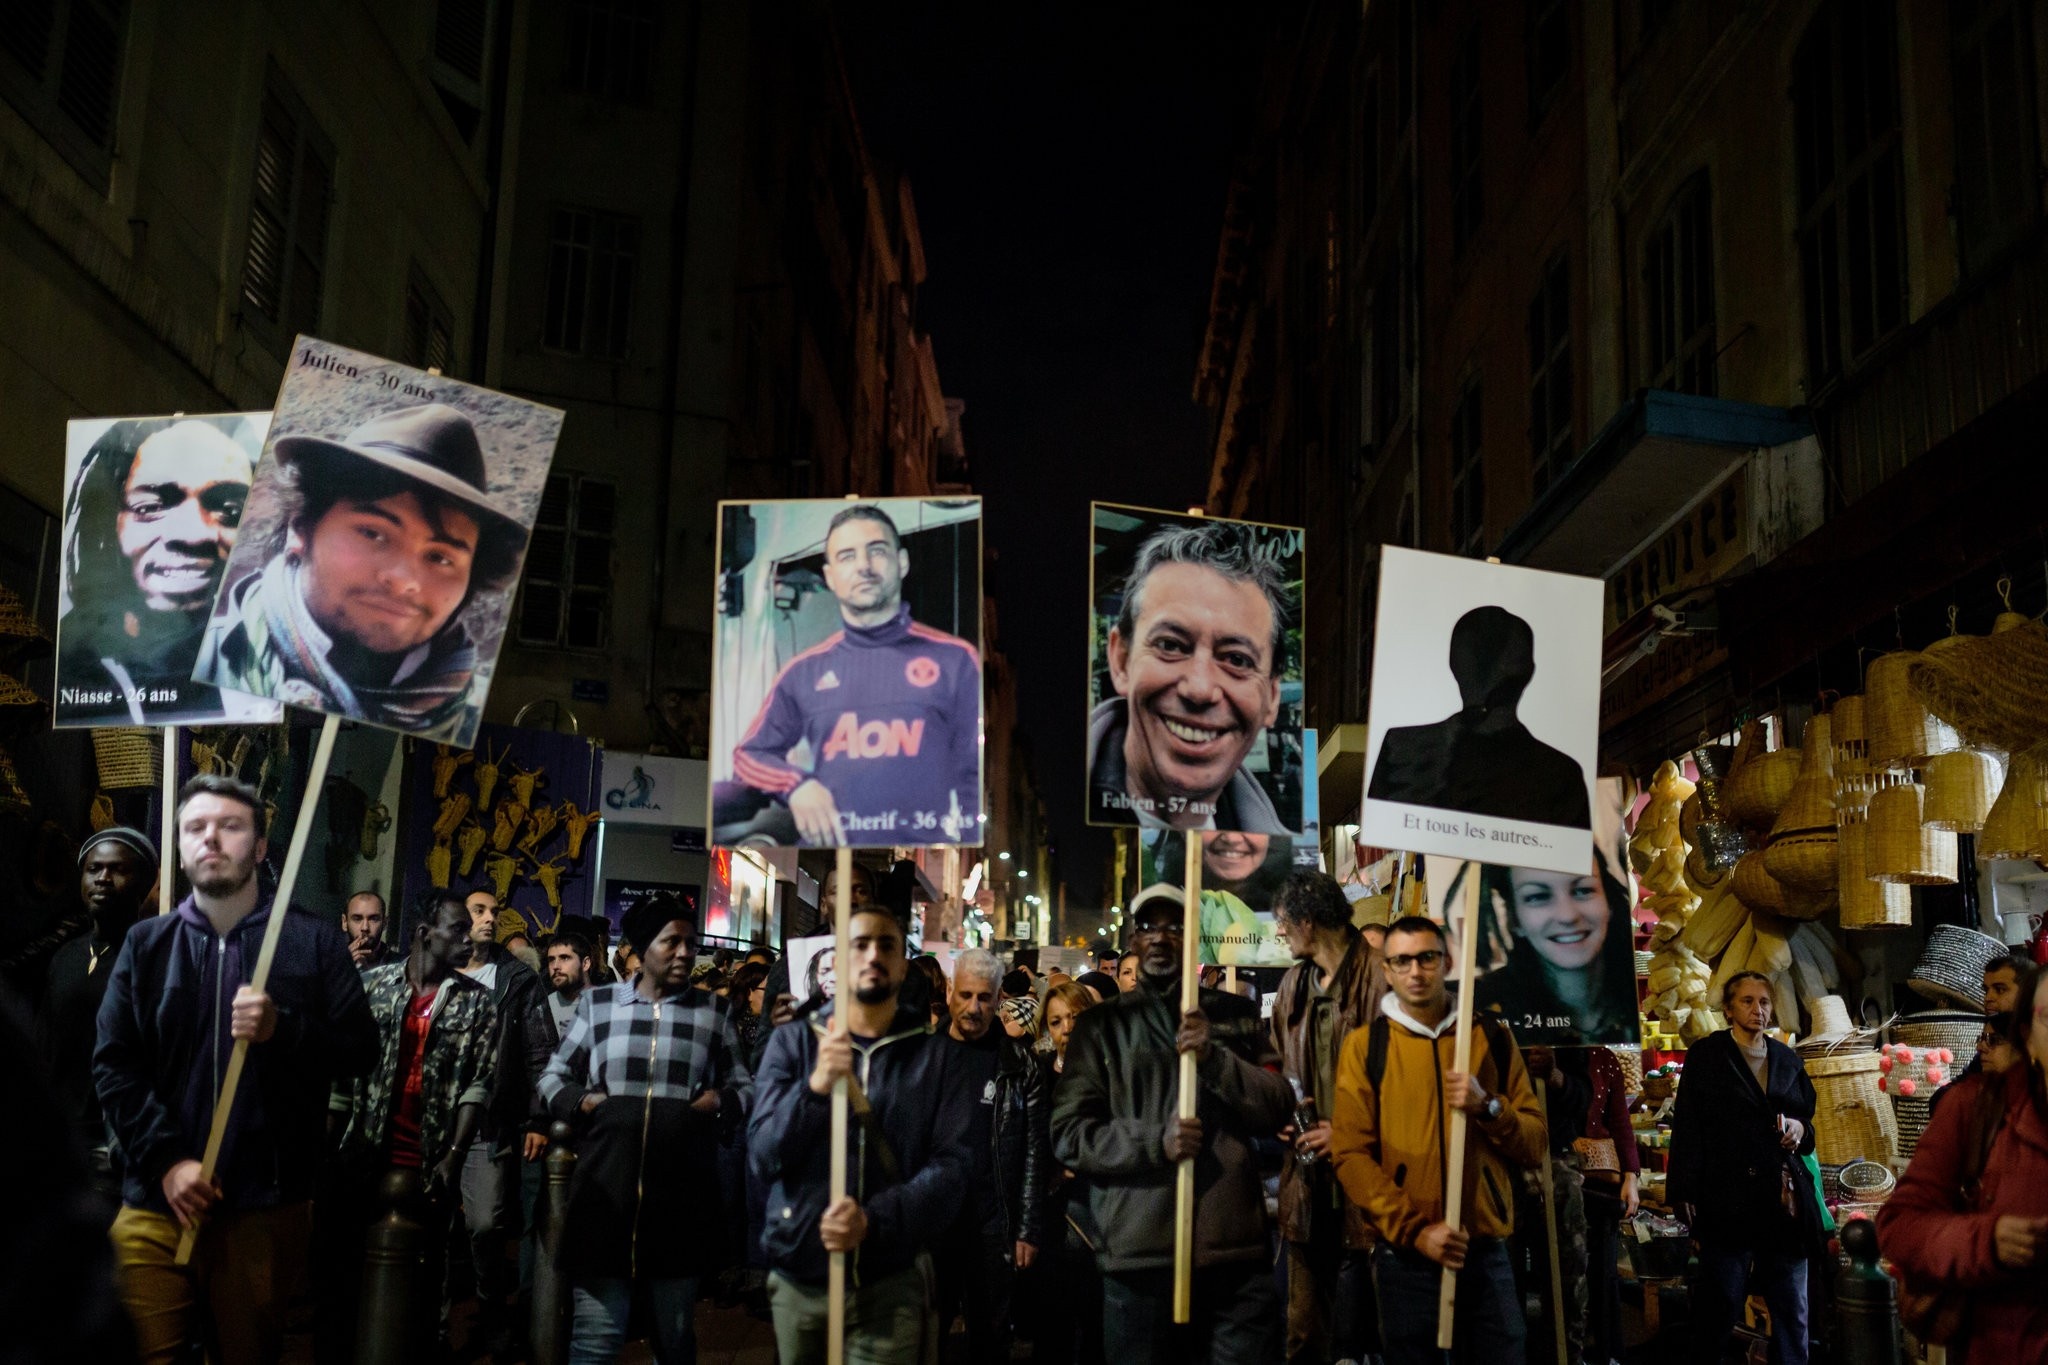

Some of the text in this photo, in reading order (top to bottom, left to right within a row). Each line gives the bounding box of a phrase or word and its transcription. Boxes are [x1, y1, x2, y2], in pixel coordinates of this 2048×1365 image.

[300, 350, 358, 378] Julien
[376, 372, 400, 390] 30
[403, 383, 436, 400] ans
[1614, 484, 1737, 624] SERVICE
[60, 688, 112, 704] Niasse
[127, 687, 146, 703] 26
[150, 690, 178, 703] ans
[822, 711, 926, 762] AON
[1101, 790, 1155, 811] Fabien
[1168, 796, 1188, 813] 57
[1190, 801, 1217, 816] ans
[840, 809, 899, 831] Cherif
[912, 810, 938, 830] 36
[1404, 813, 1553, 849] Et tous les autres...
[1524, 1013, 1543, 1029] 24
[1546, 1016, 1571, 1028] ans
